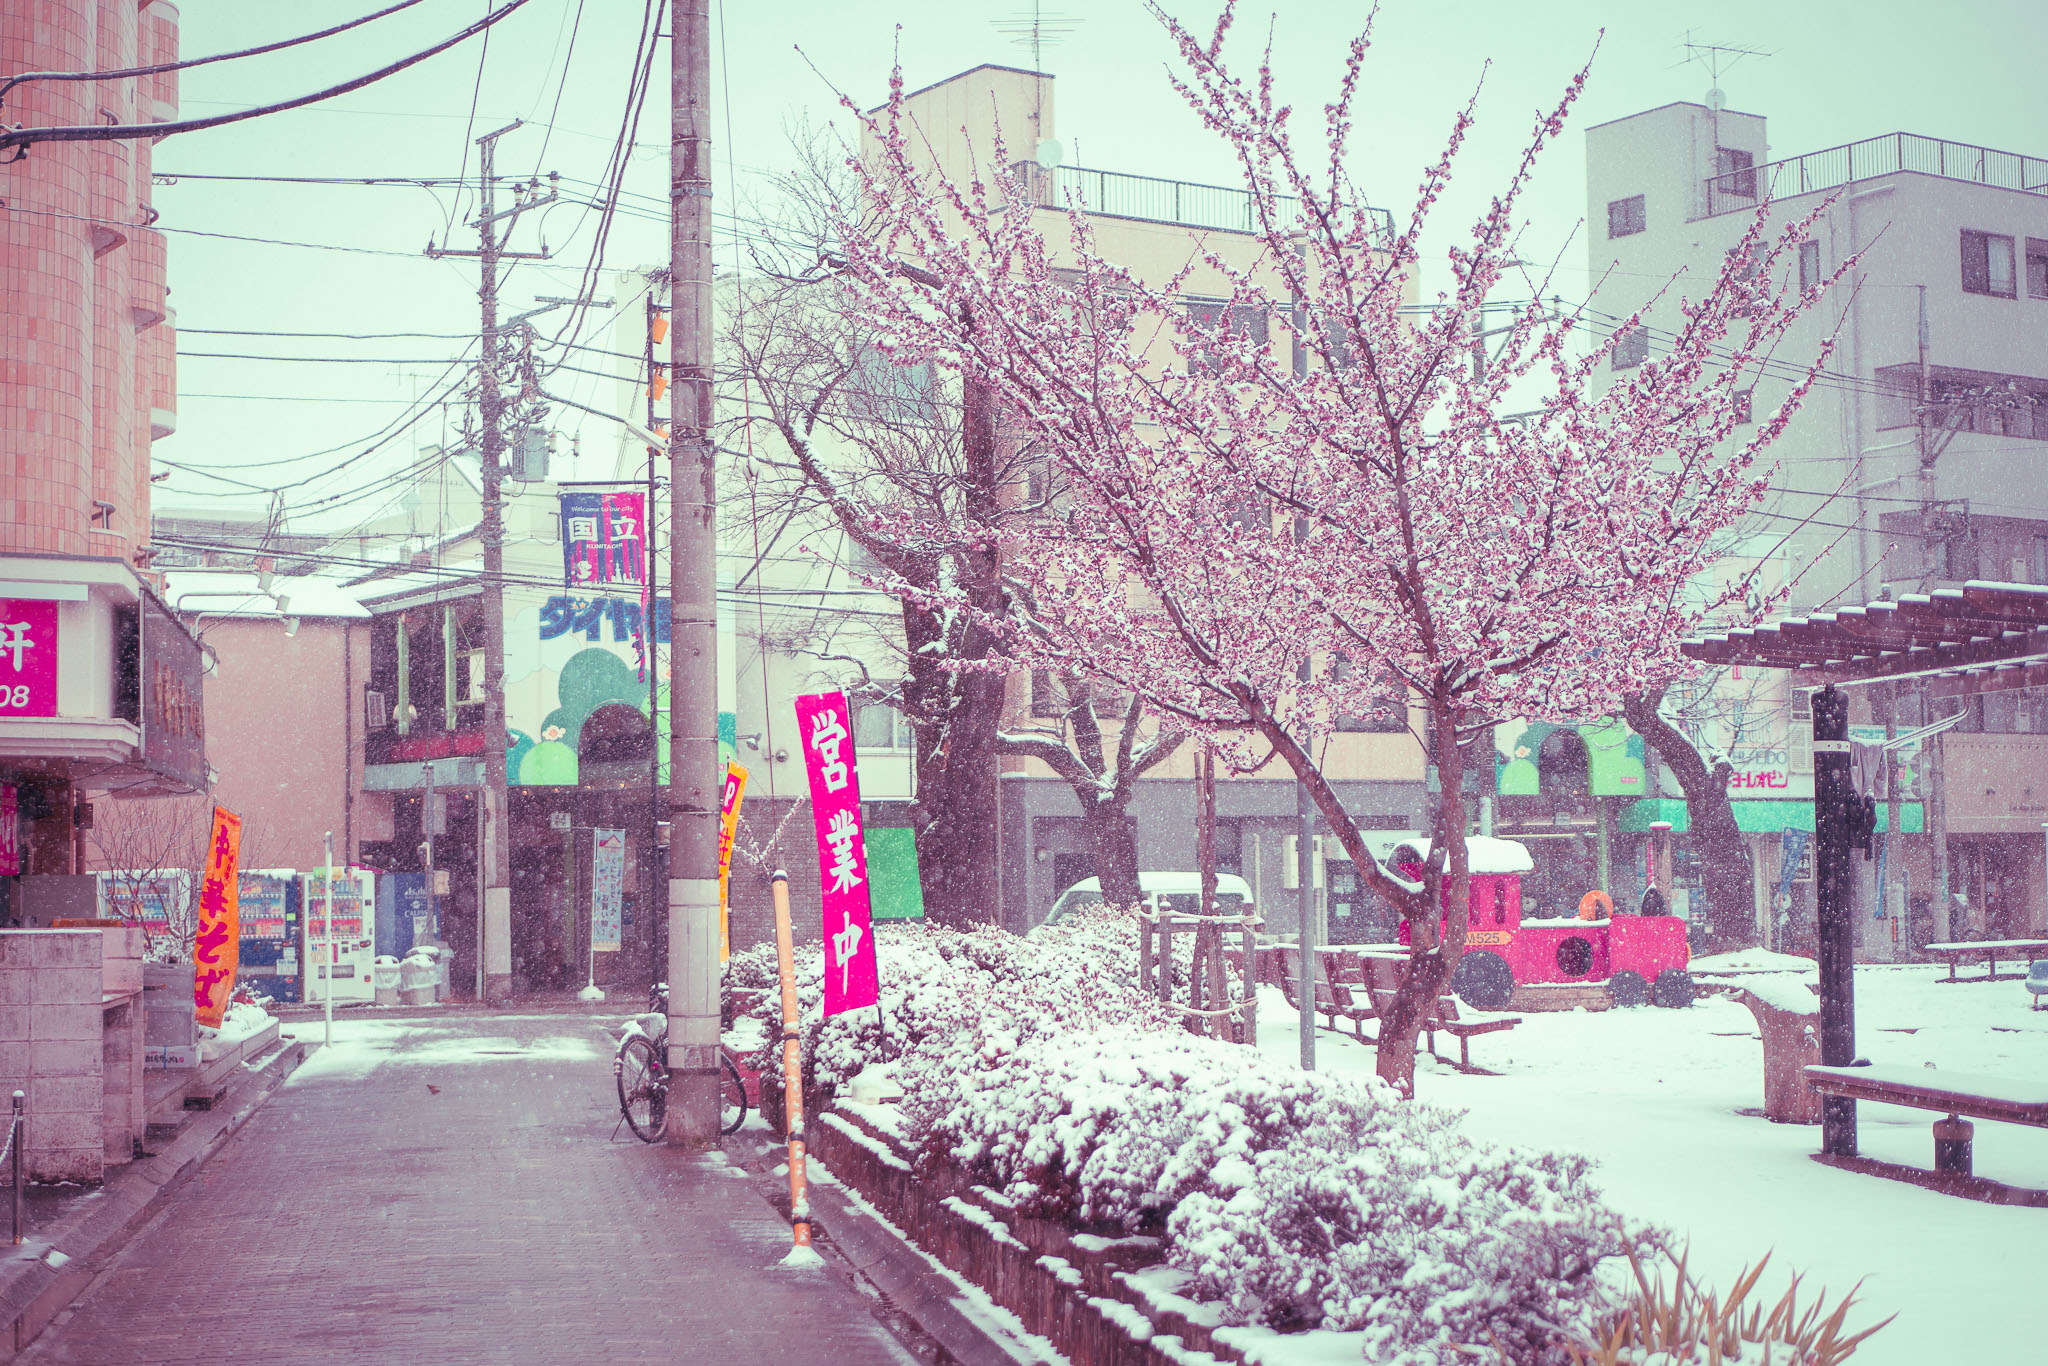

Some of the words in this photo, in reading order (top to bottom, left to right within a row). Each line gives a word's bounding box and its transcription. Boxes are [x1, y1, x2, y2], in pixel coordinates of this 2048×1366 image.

[571, 505, 600, 513] Welcome
[621, 505, 634, 513] city
[568, 515, 639, 544] 国立
[586, 542, 623, 550] KUNITACHI
[540, 595, 671, 643] ダイヤ
[811, 708, 864, 996] 営業中
[194, 824, 229, 1009] 中華そば
